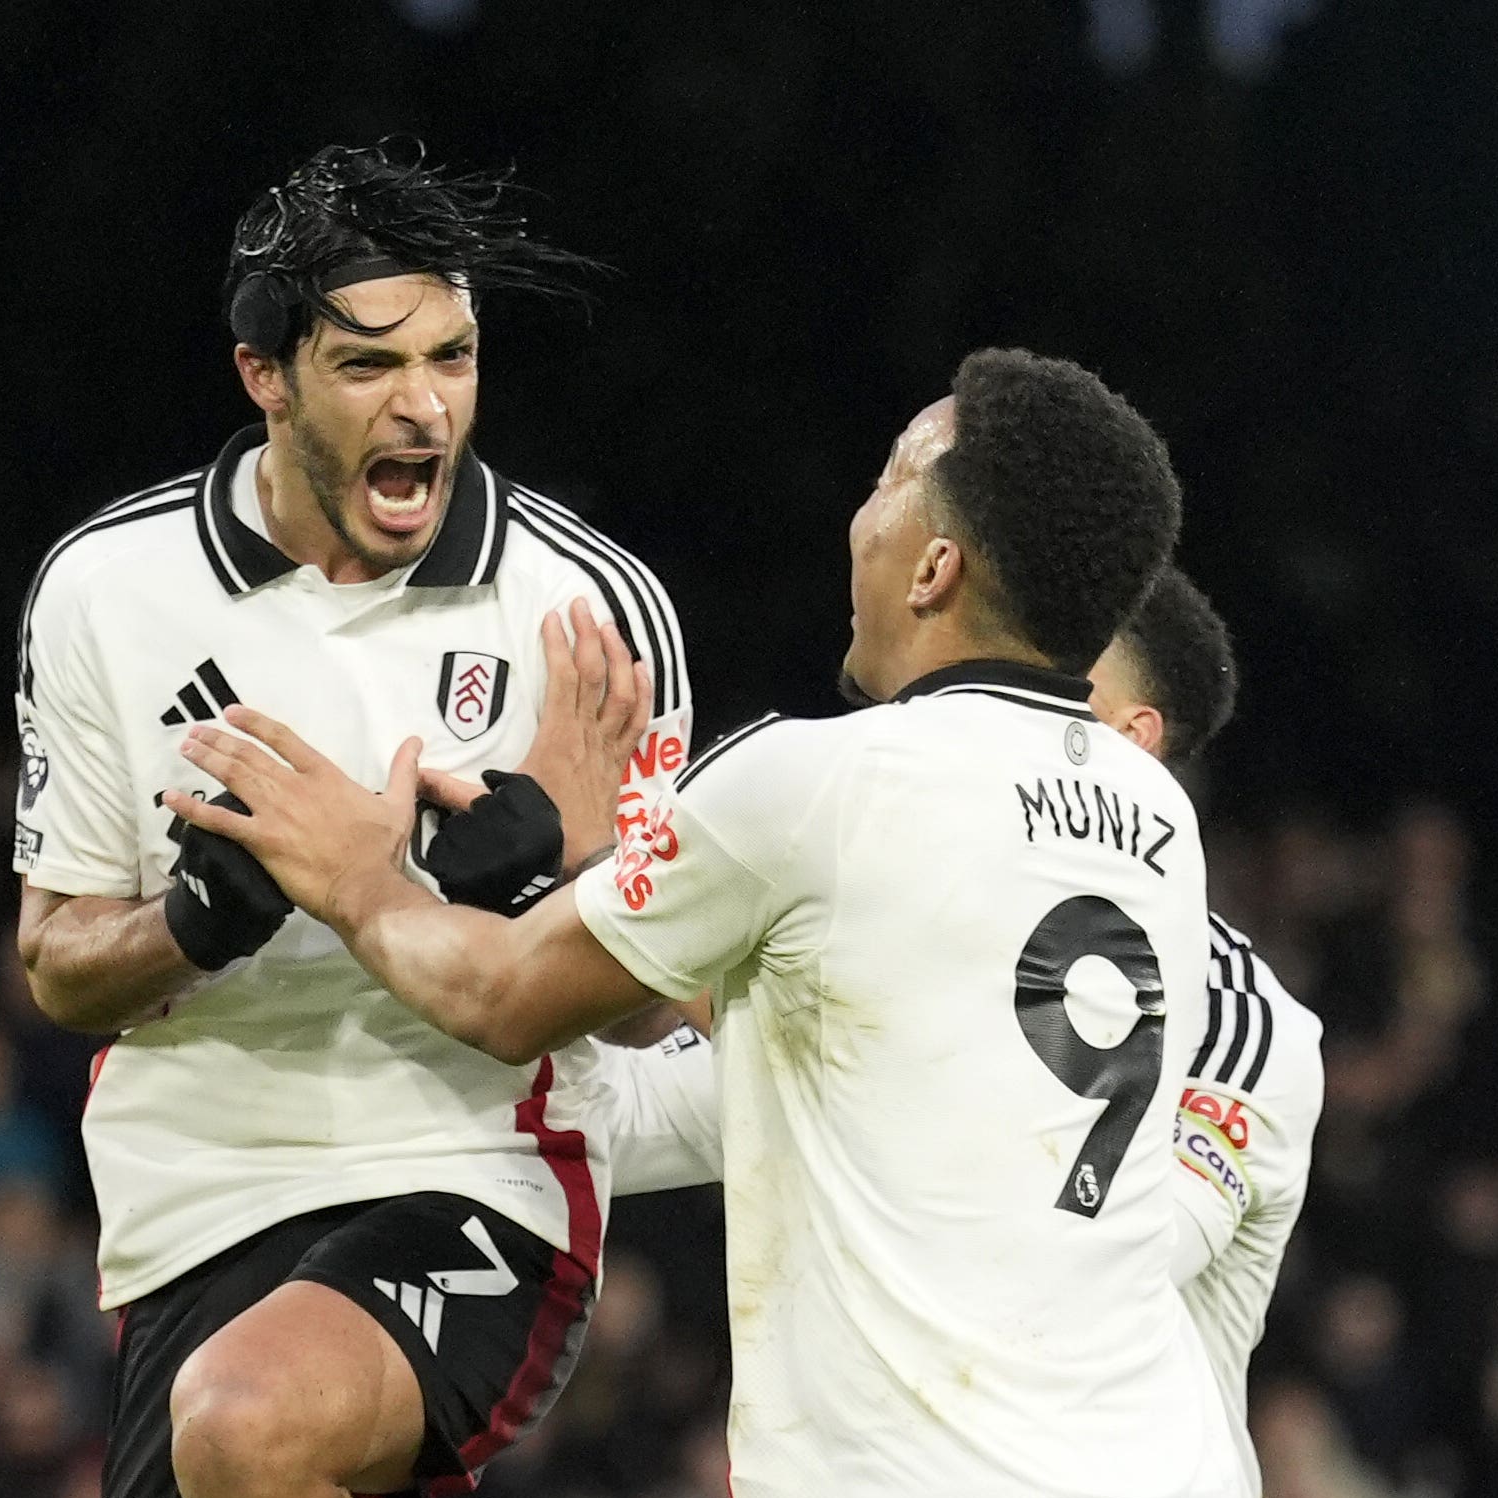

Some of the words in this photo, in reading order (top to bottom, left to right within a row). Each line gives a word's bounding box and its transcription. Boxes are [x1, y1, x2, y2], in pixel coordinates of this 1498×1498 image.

[455, 663, 491, 723] FFC
[620, 731, 685, 785] We
[1014, 777, 1175, 878] MUNIZ
[1014, 895, 1167, 1219] 9
[1179, 1087, 1249, 1151] eb
